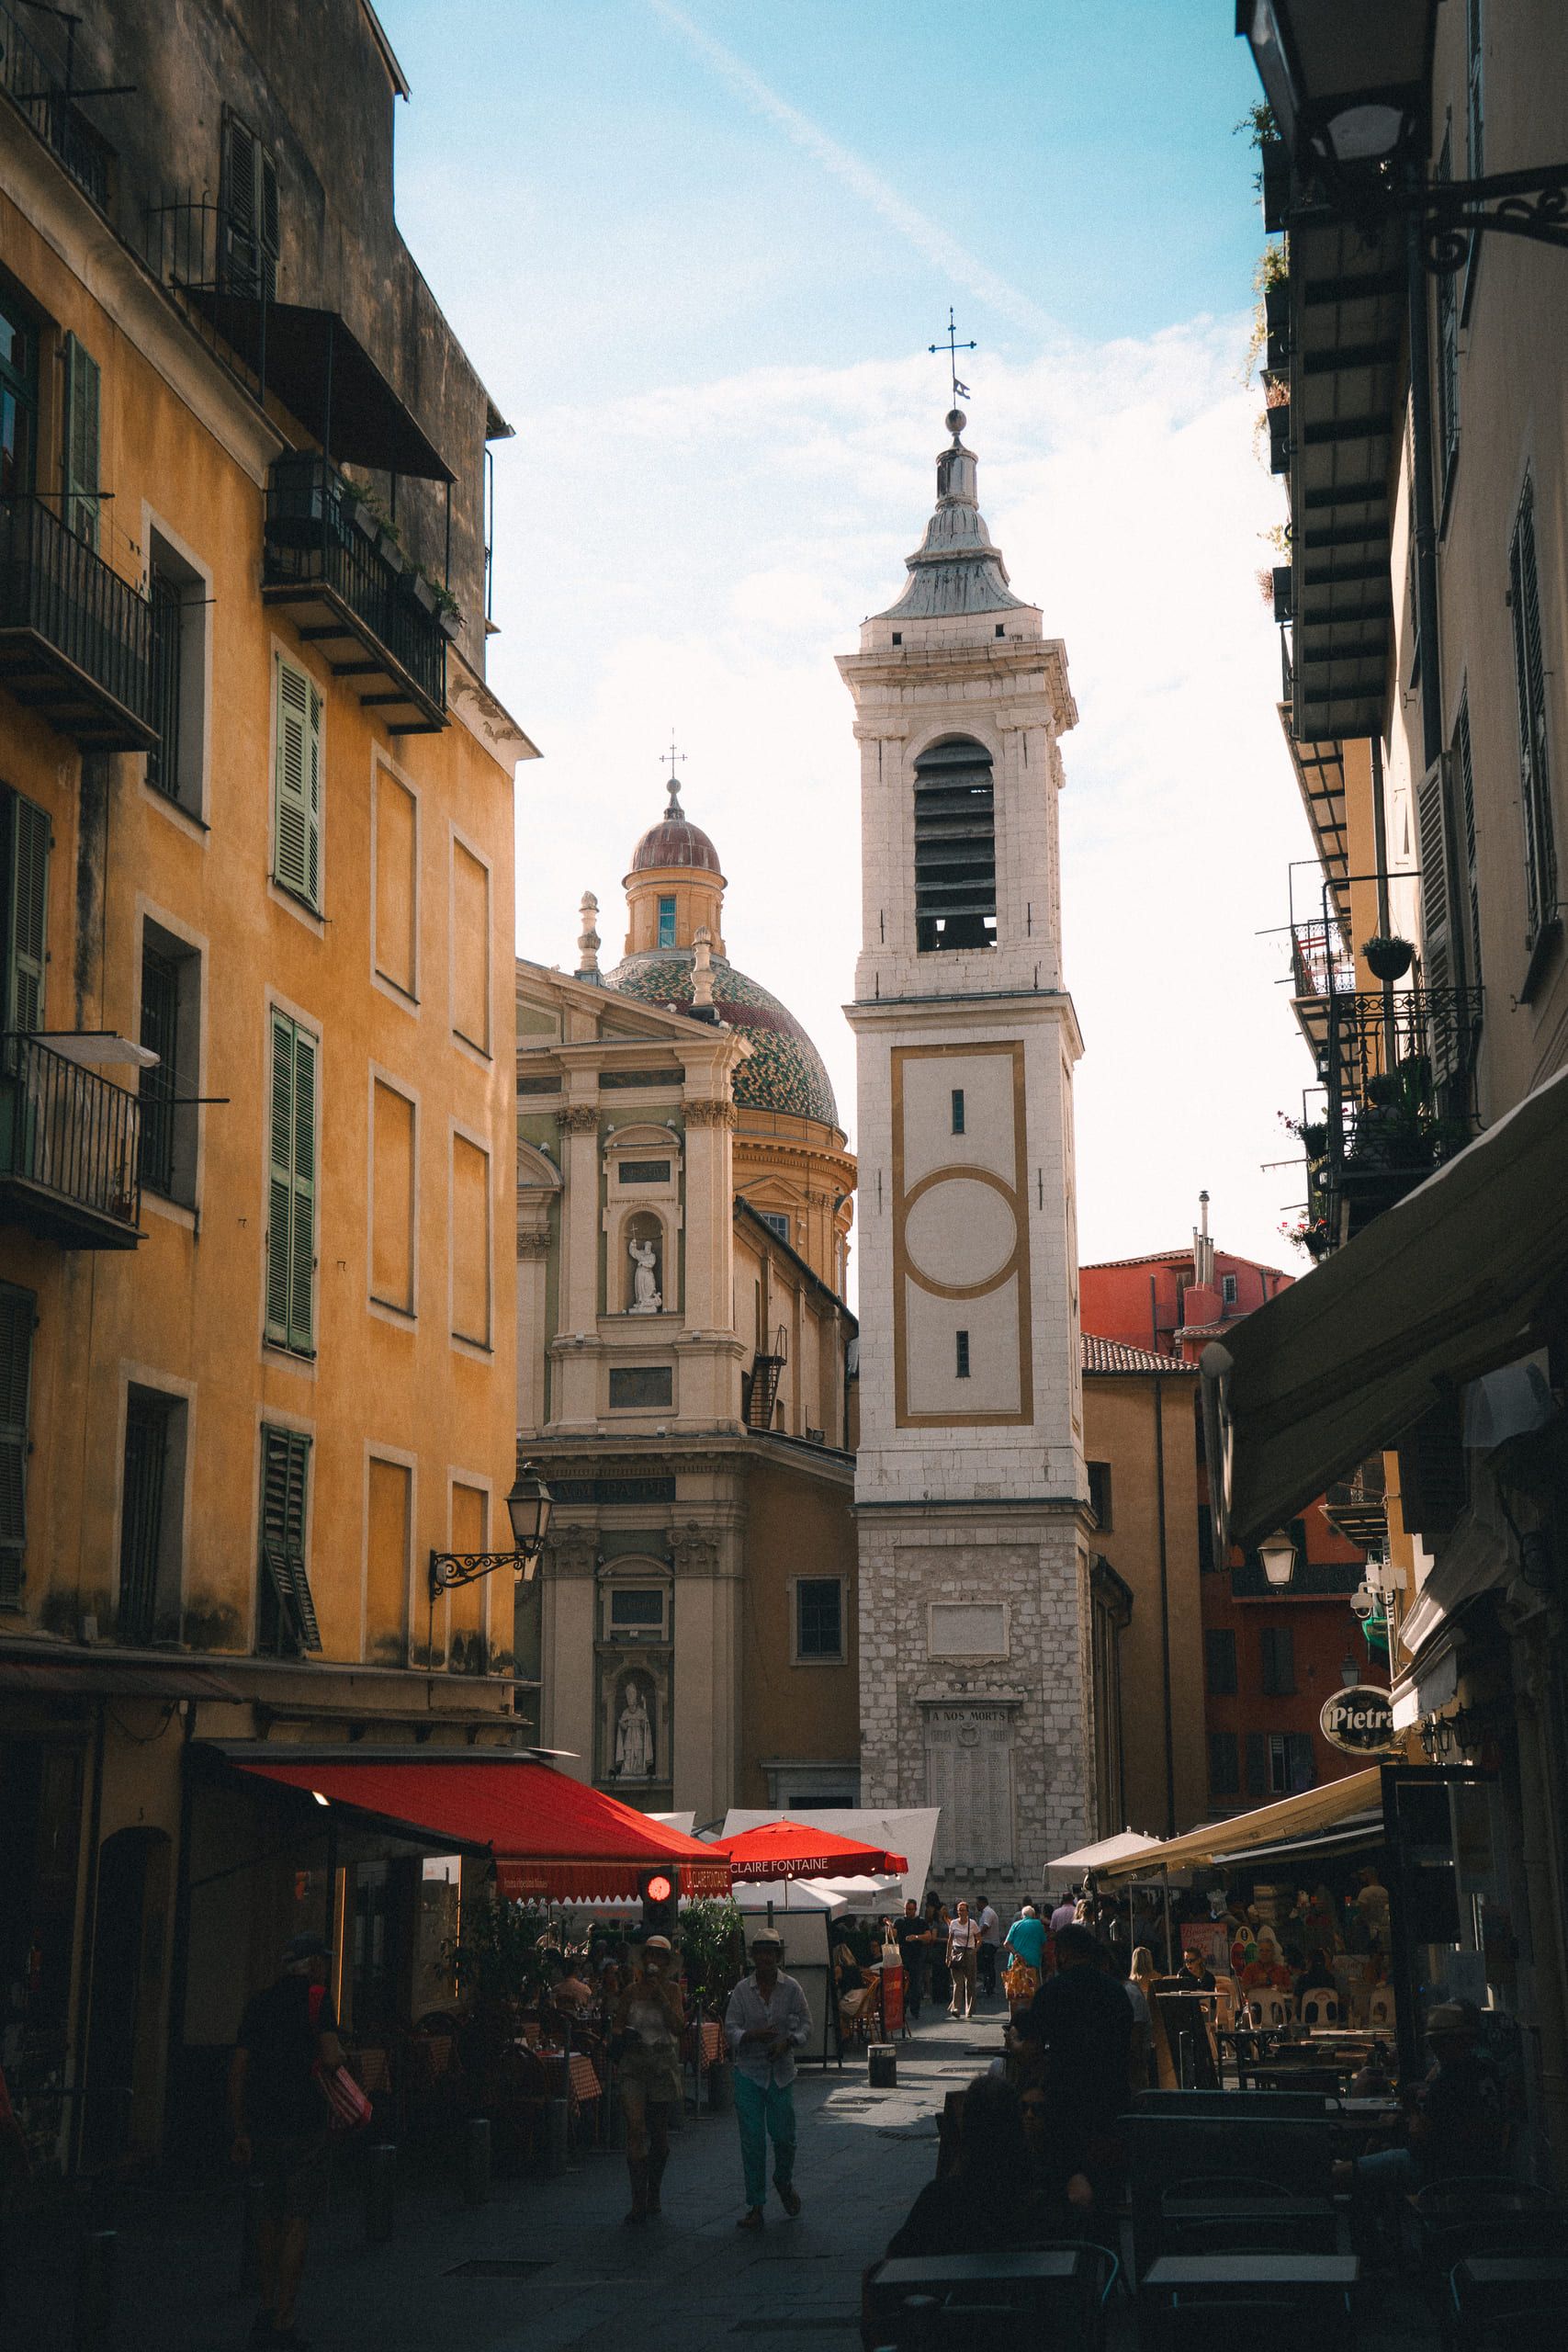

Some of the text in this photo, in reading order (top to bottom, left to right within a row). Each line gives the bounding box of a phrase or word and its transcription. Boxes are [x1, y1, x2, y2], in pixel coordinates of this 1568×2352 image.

[943, 1712, 964, 1721] NOS
[969, 1712, 1005, 1721] MORTS
[730, 1858, 829, 1873] CLAIRE FONTAINE
